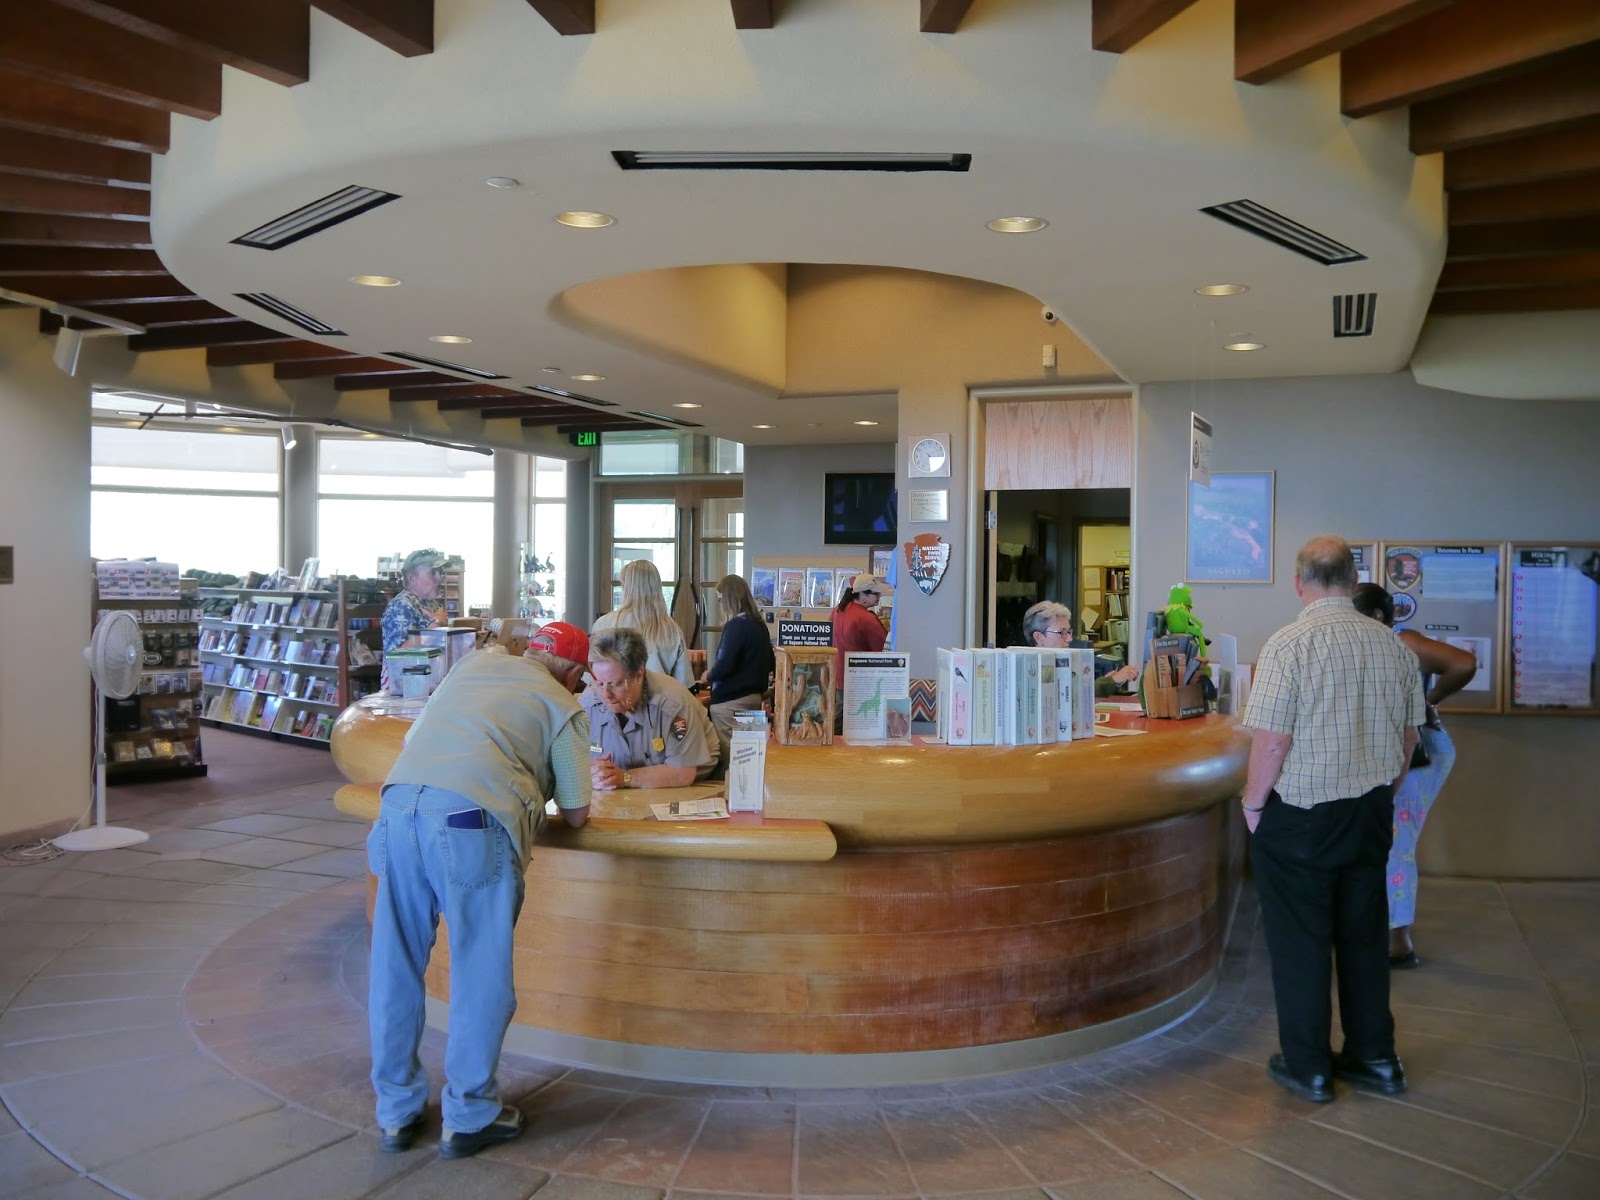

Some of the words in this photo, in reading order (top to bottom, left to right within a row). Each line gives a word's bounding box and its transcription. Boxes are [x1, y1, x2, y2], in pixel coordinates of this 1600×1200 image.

[577, 432, 596, 445] EXIT
[1531, 551, 1556, 560] Hiking
[1208, 568, 1250, 576] SAGUARO
[781, 623, 831, 633] DONATIONS
